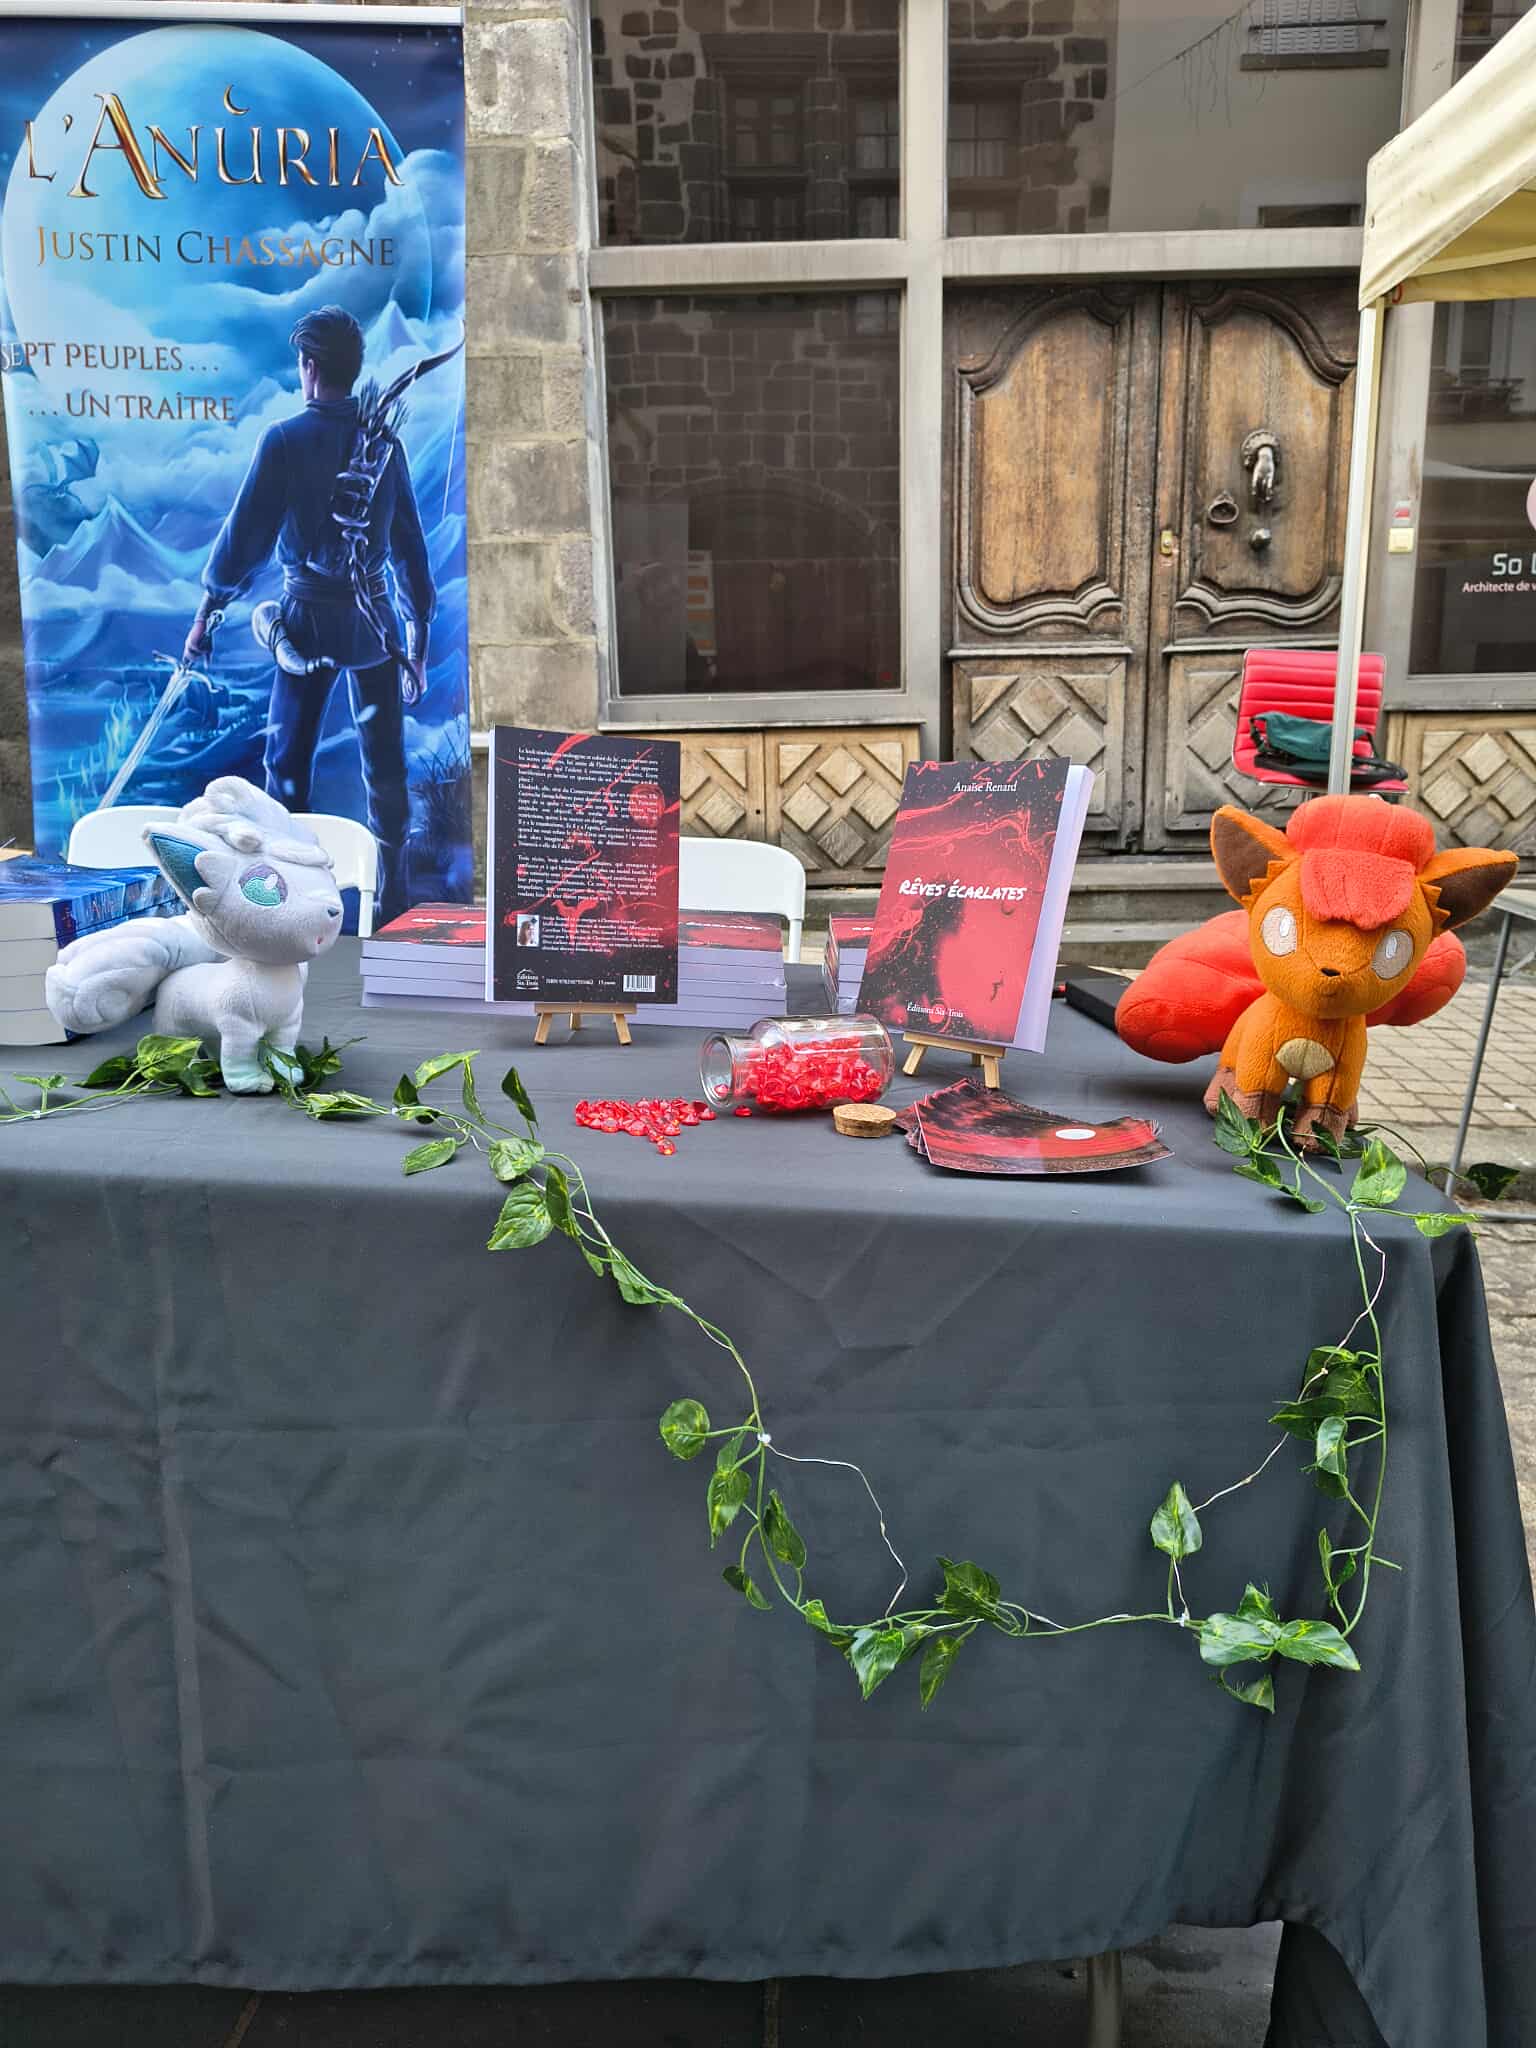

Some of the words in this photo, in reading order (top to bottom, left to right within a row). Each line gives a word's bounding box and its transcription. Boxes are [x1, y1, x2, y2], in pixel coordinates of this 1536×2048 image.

[36, 226, 162, 268] JUSTIN
[176, 230, 395, 268] CHASSAGNE
[1491, 552, 1523, 576] So
[1462, 581, 1515, 592] Architecte
[1516, 580, 1530, 591] de
[985, 780, 1018, 792] Renard
[898, 877, 945, 897] RÊVES
[947, 878, 1027, 901] ÉCARLATES
